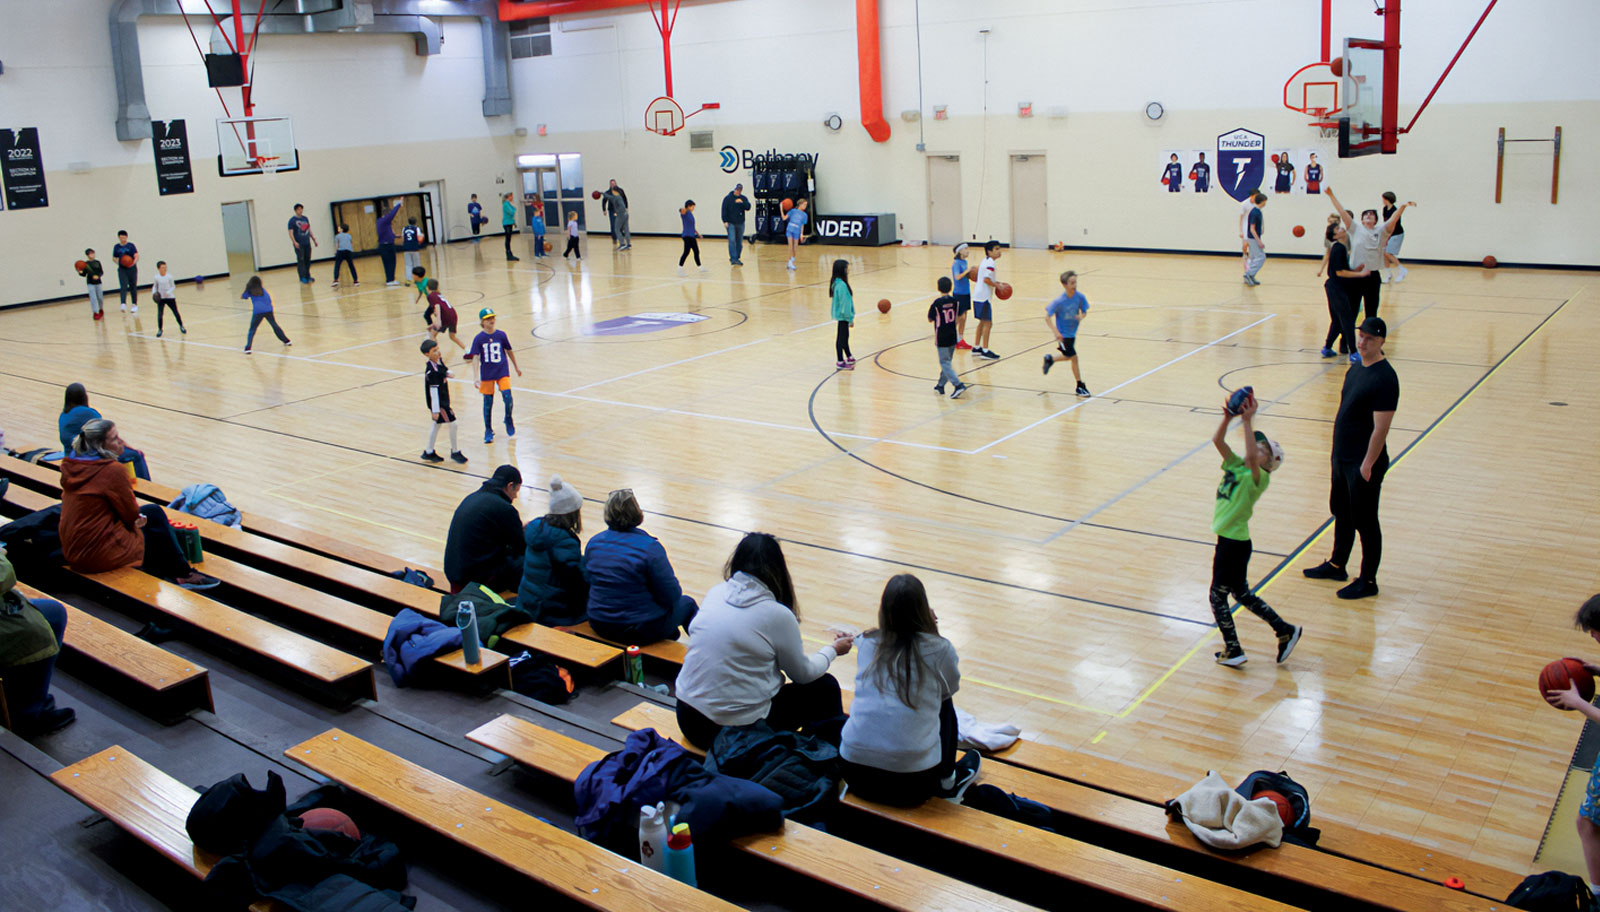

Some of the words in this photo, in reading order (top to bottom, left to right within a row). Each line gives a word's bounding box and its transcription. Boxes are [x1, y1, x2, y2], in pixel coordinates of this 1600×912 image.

[160, 139, 181, 148] 2023
[7, 148, 33, 158] 2022
[816, 220, 863, 237] NDER
[943, 309, 955, 323] 10
[482, 342, 502, 363] 18
